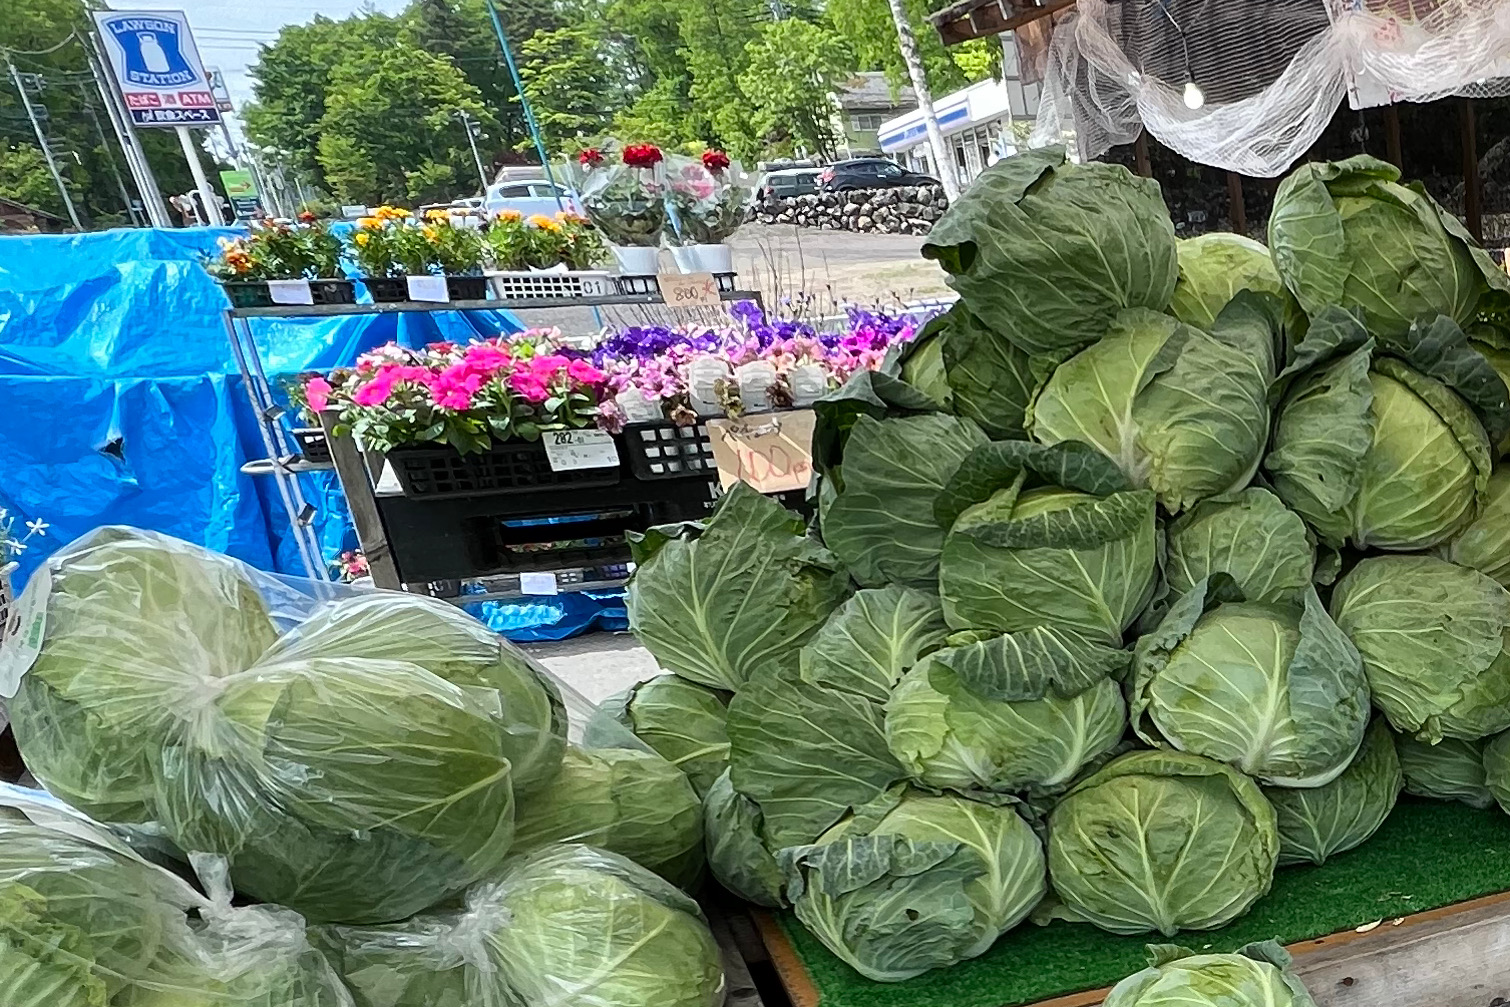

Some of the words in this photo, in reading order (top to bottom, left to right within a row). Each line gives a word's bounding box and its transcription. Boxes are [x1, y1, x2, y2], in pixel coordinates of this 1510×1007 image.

[110, 20, 176, 35] LAWSON
[129, 70, 193, 85] STATION
[182, 93, 211, 104] ATM
